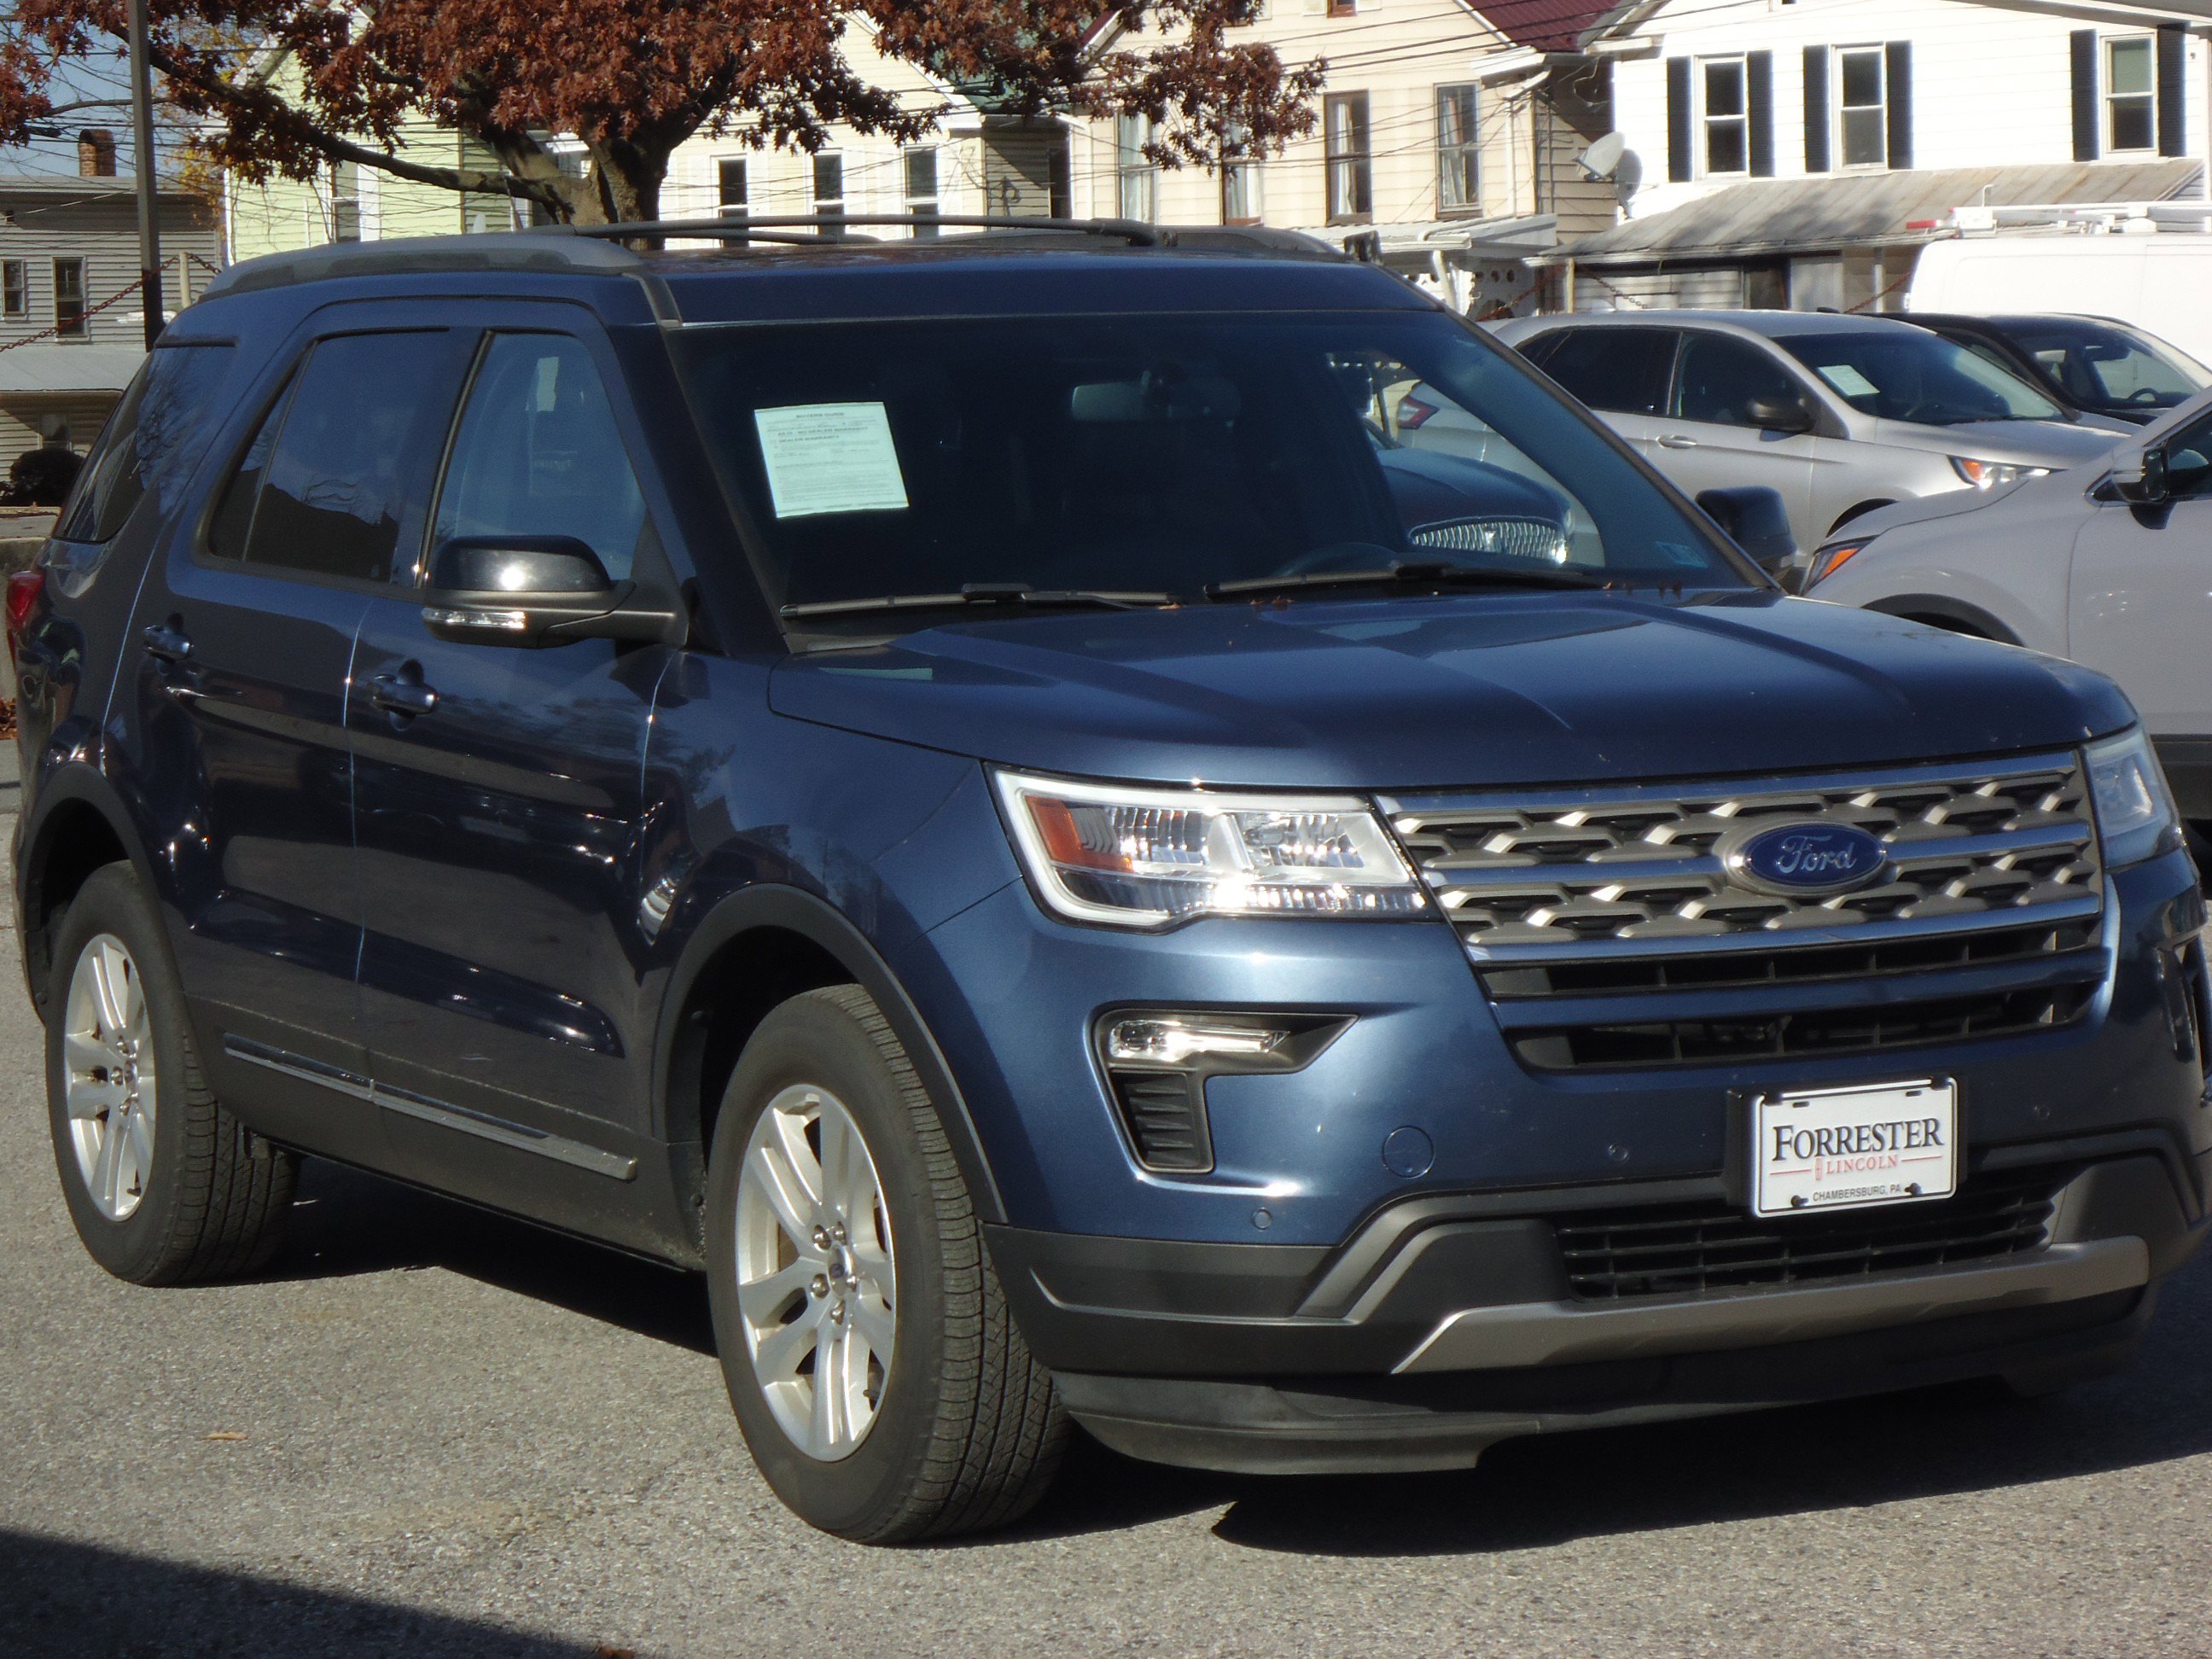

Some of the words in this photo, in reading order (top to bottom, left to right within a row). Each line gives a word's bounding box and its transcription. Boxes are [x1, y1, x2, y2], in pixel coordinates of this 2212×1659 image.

[1776, 835, 1858, 874] Ford
[1772, 1117, 1945, 1162] FORRESTER
[1825, 1154, 1900, 1175] LINCOLN
[1889, 1184, 1901, 1194] PA
